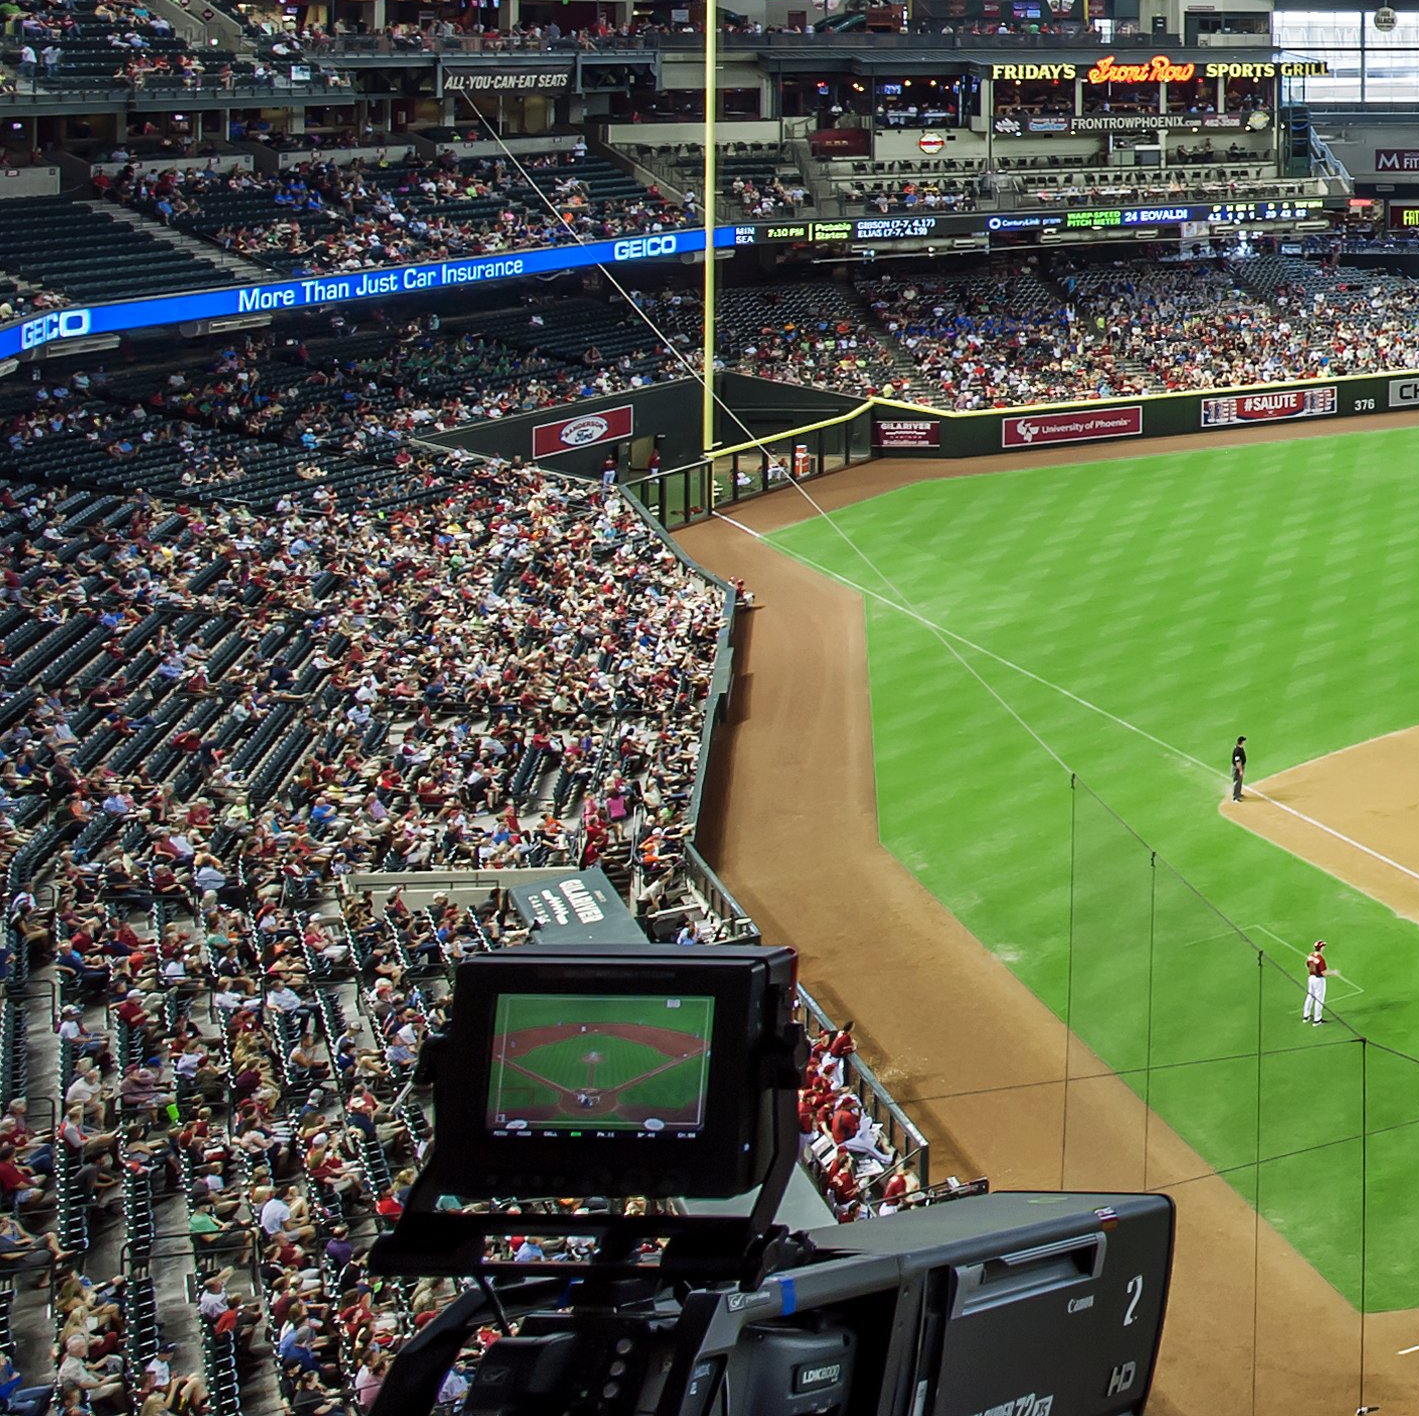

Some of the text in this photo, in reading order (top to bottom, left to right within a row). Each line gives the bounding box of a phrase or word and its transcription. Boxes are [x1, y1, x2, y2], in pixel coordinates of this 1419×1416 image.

[992, 63, 1076, 80] FRIDAY'S
[1089, 56, 1195, 83] Front Row
[1206, 62, 1330, 77] SPORTS GRILL
[538, 74, 568, 87] SEATS
[1071, 116, 1202, 130] FRONTROWPHOENIX.com
[614, 236, 677, 261] GEICO
[238, 260, 523, 313] More Than Just Car Insurance
[21, 308, 91, 350] GEICO
[1244, 394, 1298, 412] #SALUTE
[1354, 398, 1376, 411] 376
[1041, 419, 1129, 436] University Phoenix
[1068, 1295, 1094, 1314] Canon
[1123, 1274, 1143, 1326] 2
[1107, 1361, 1136, 1397] HD
